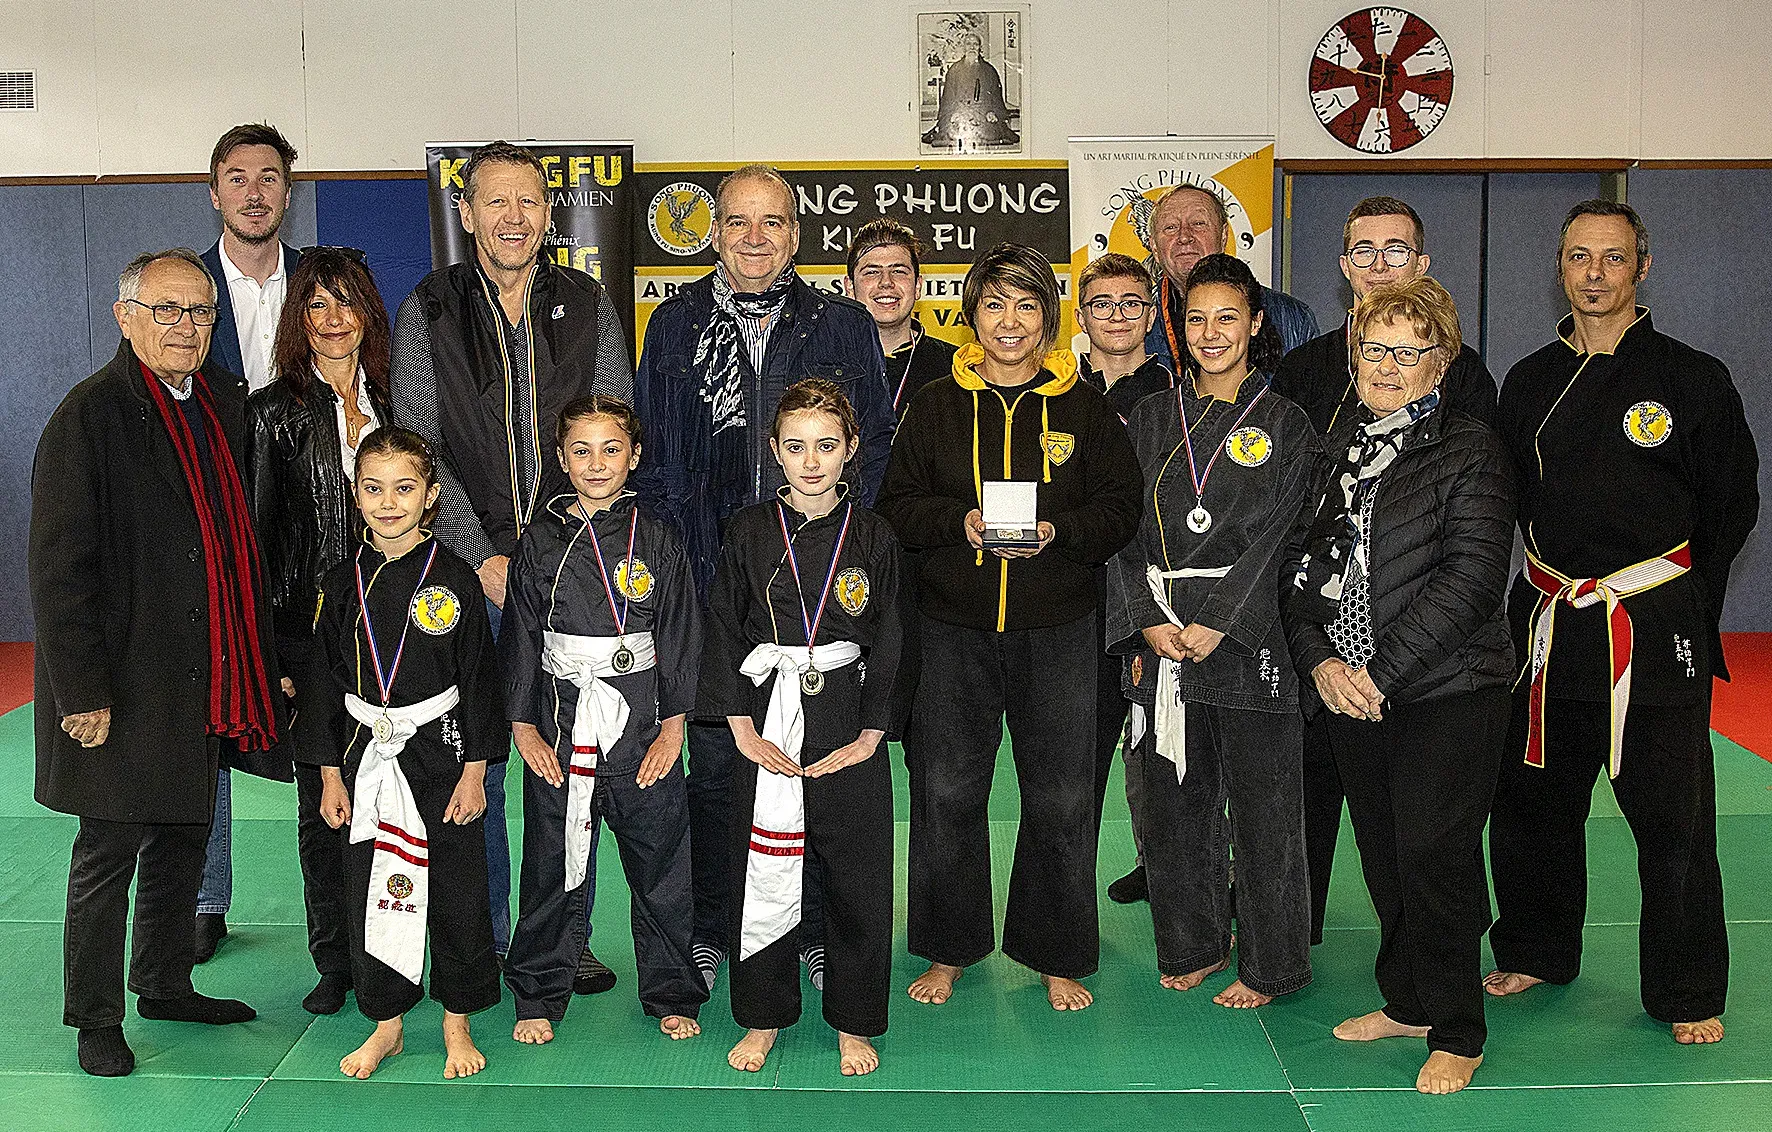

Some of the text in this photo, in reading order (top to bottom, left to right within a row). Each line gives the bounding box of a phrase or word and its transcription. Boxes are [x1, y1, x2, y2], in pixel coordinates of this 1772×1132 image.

[650, 183, 715, 212] SONG PHUONG
[796, 182, 1061, 215] NG PHUONG
[931, 223, 976, 251] FU
